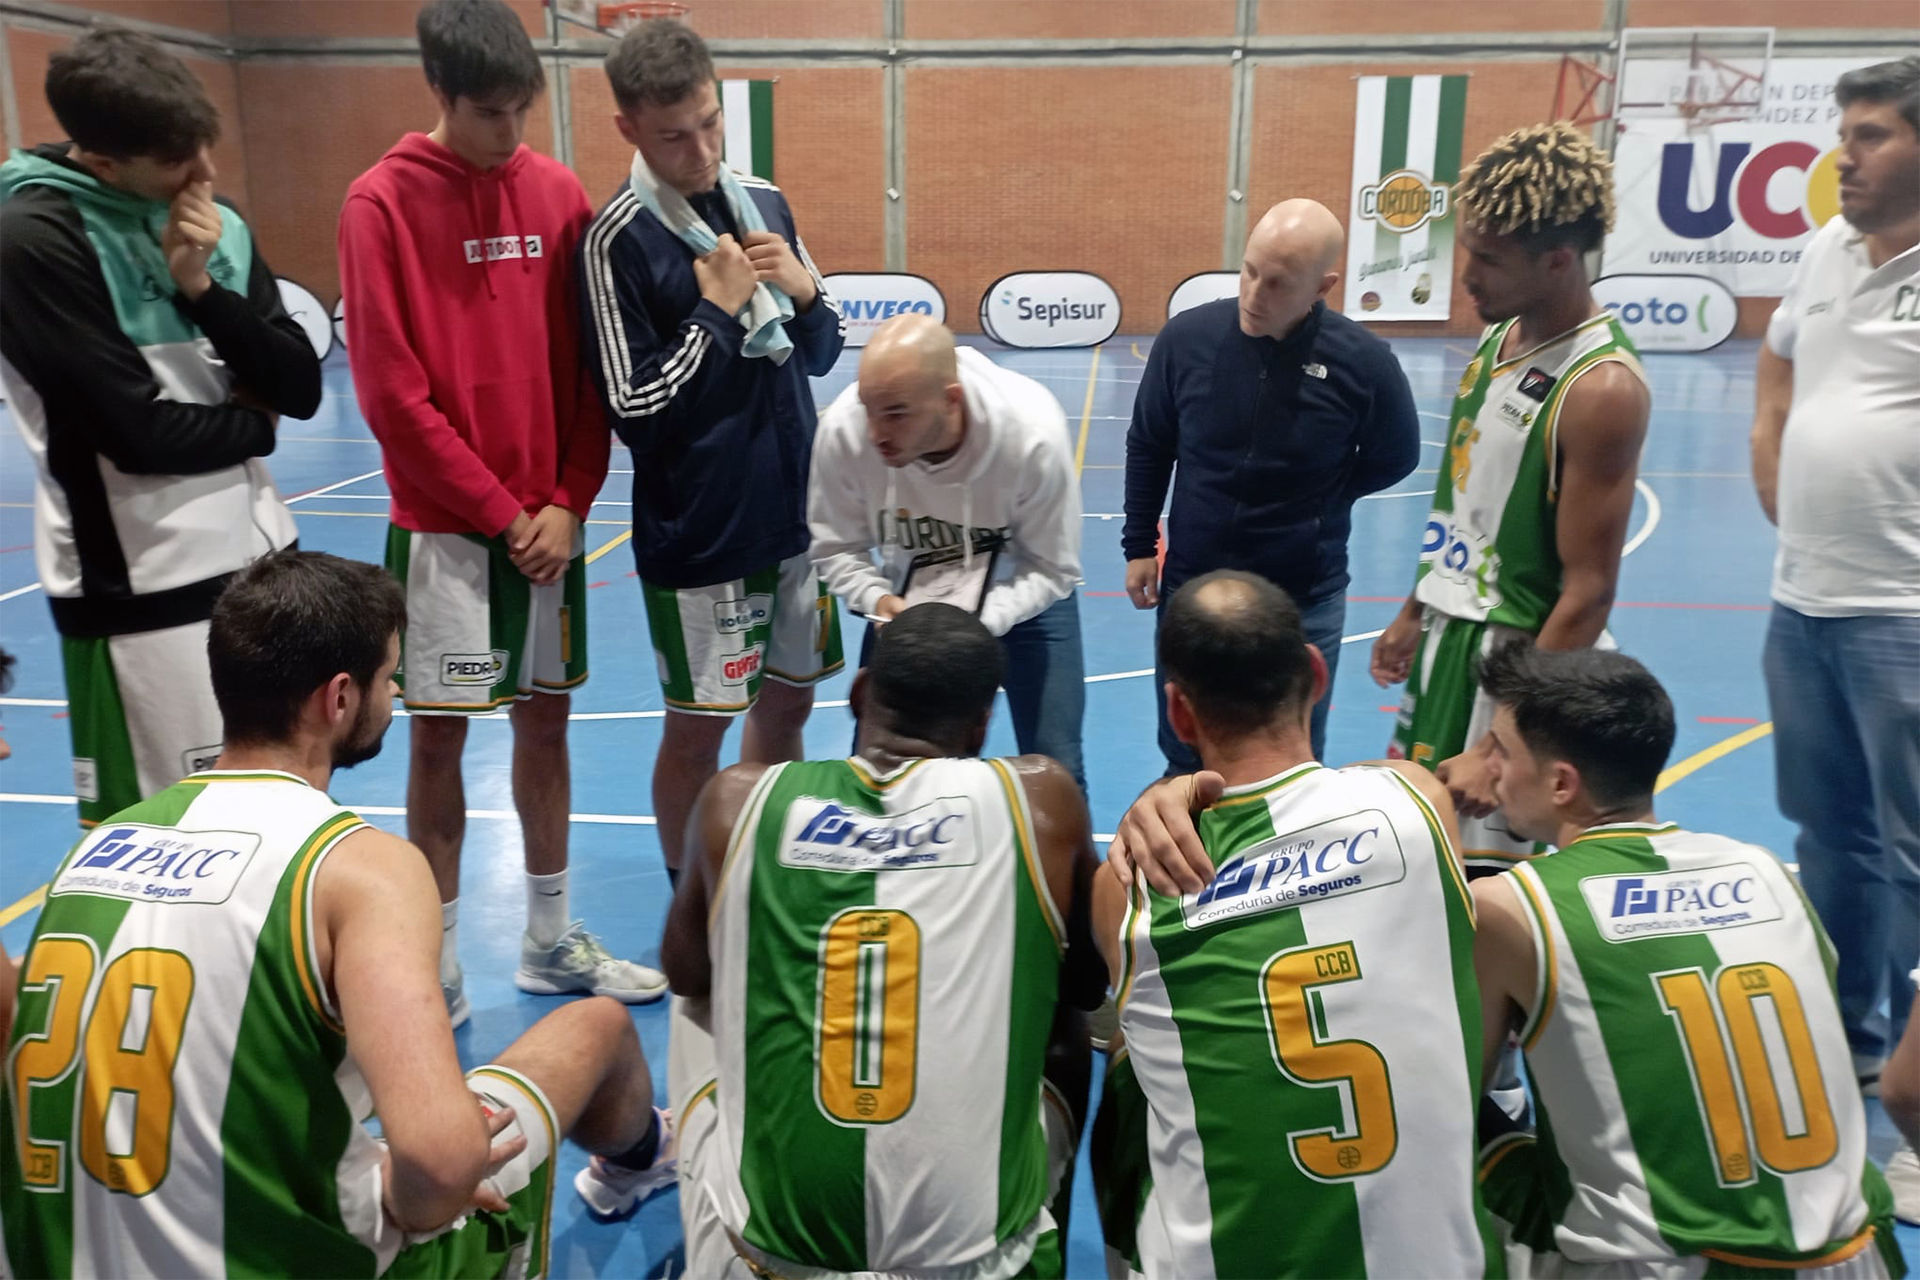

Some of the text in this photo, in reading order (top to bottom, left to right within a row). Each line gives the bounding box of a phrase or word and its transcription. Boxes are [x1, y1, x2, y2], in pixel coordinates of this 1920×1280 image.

[1649, 250, 1775, 264] UNIVERSIDAD
[1018, 297, 1106, 327] Sepisur
[116, 846, 241, 879] PACC
[1256, 828, 1379, 892] PACC
[1270, 839, 1315, 859] GRUPO
[1197, 875, 1362, 921] Correduria de Seguros
[1664, 877, 1754, 913] PACC
[1314, 951, 1352, 978] CCB
[814, 906, 921, 1128] 0
[6, 933, 195, 1197] 28
[1258, 940, 1398, 1184] 5
[1648, 962, 1840, 1188] 10
